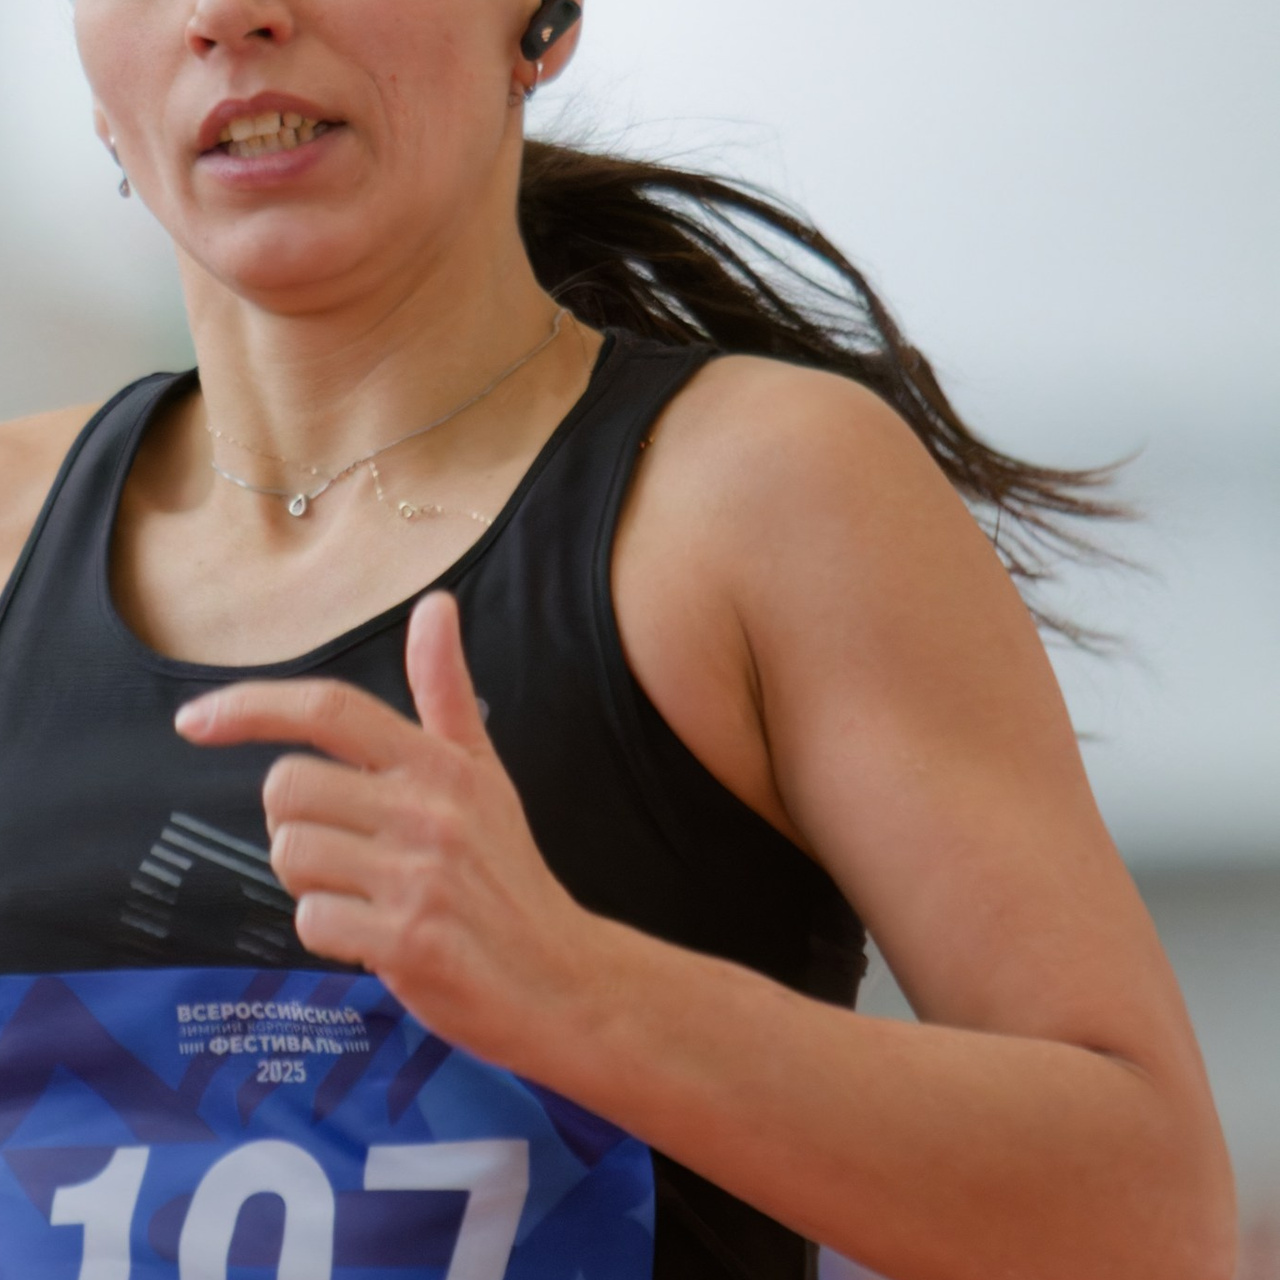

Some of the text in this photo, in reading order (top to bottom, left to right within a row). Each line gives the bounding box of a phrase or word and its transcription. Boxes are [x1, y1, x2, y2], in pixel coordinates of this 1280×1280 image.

[177, 1001, 363, 1023] ВСЕРОССИЙСКИЙ
[209, 1035, 343, 1055] ФЕСТИВАЛЬ
[256, 1060, 307, 1083] 2025
